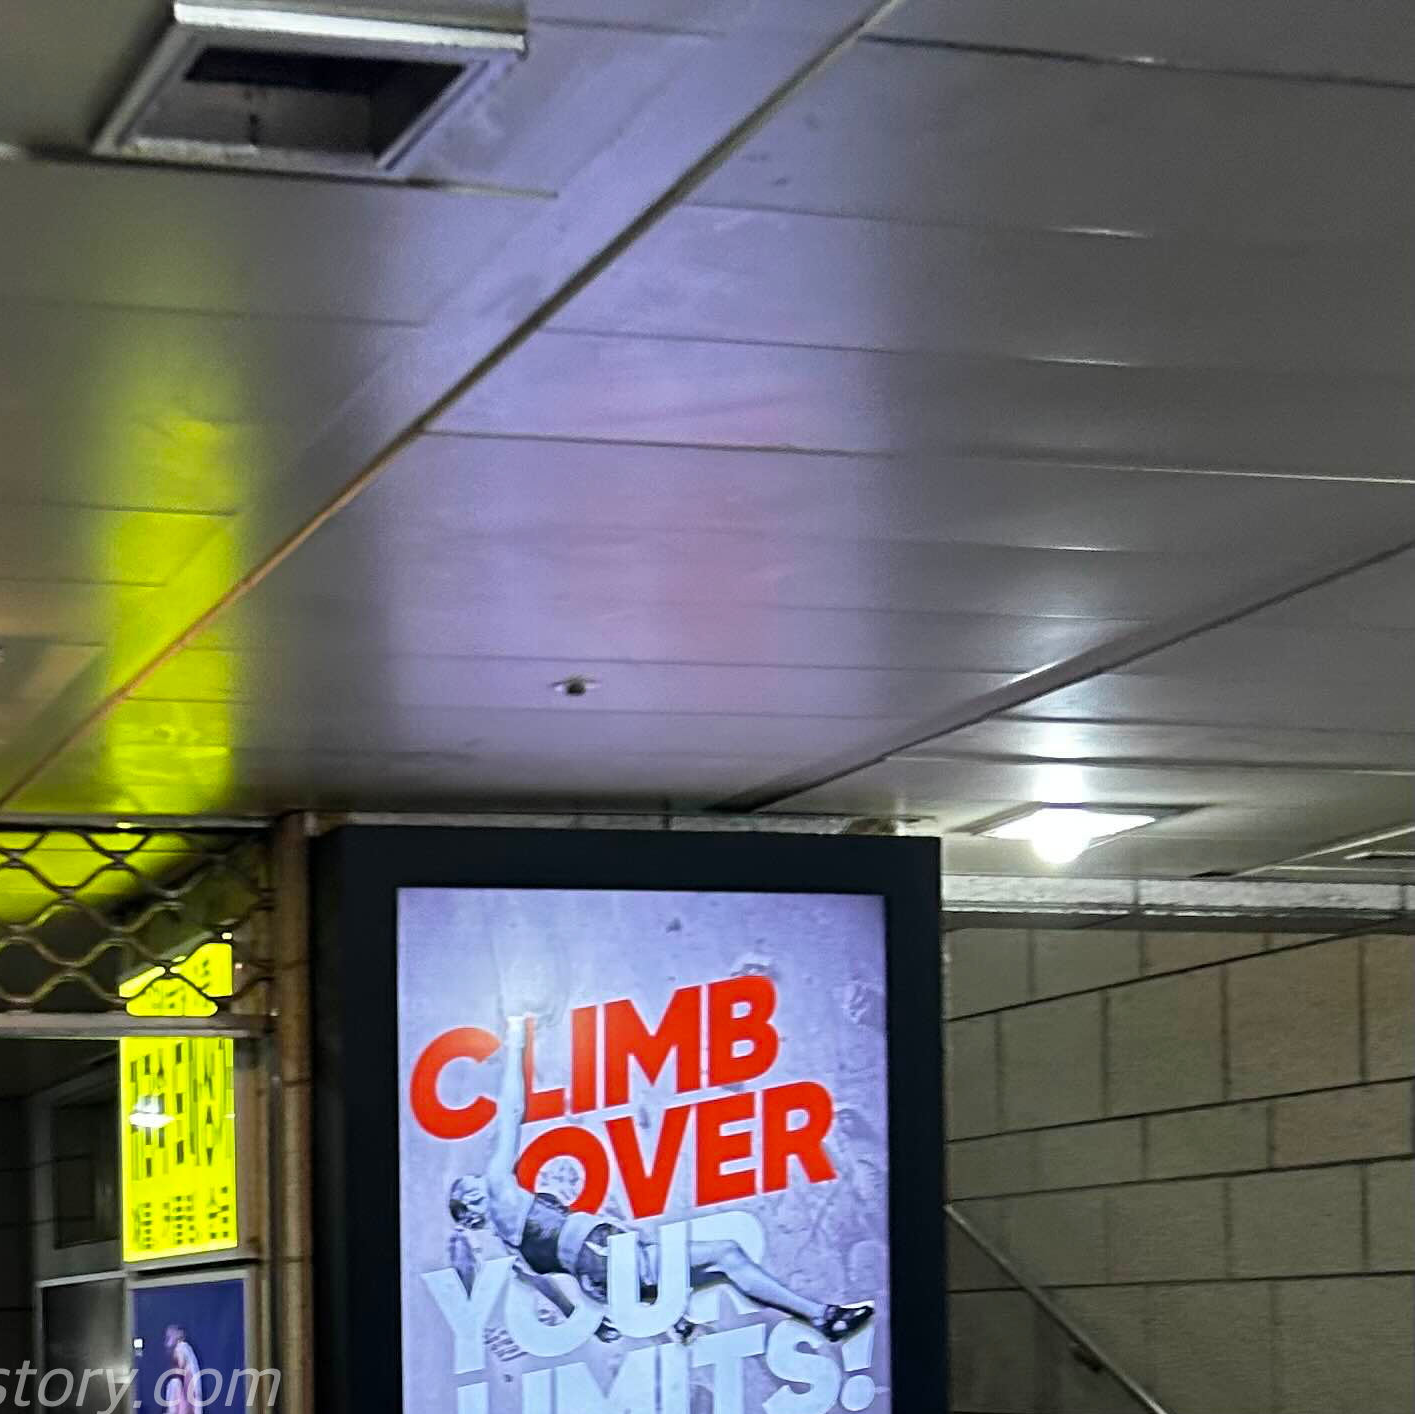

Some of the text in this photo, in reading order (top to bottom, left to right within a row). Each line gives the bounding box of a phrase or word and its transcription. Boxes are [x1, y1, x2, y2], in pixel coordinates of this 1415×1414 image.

[409, 975, 779, 1140] CLIMB
[513, 1080, 838, 1220] OVER
[420, 1211, 767, 1375] YOUR
